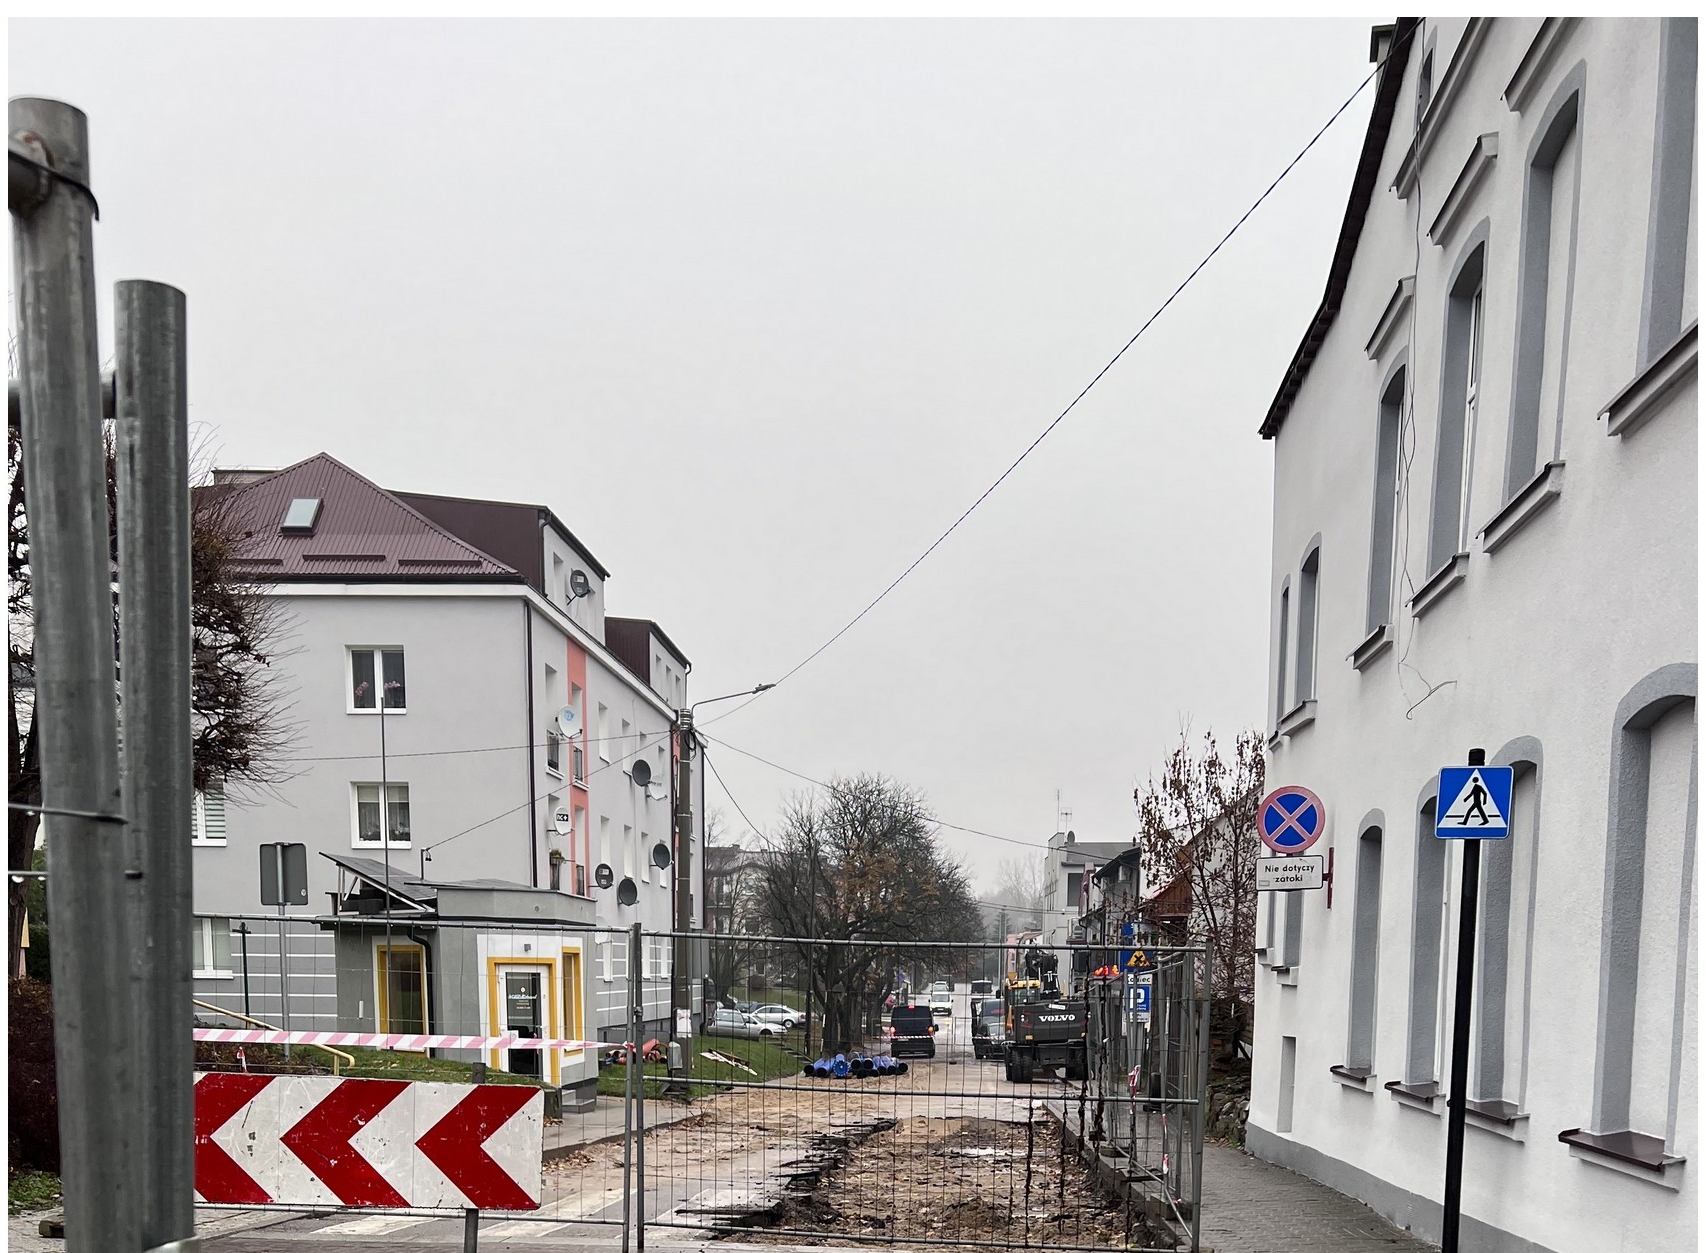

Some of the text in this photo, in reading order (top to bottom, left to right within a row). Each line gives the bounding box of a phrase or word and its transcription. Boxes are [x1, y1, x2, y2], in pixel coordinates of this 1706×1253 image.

[1264, 864, 1315, 874] Nie dotyczy
[1275, 874, 1303, 882] zatoki
[1039, 1014, 1076, 1022] VOLVO
